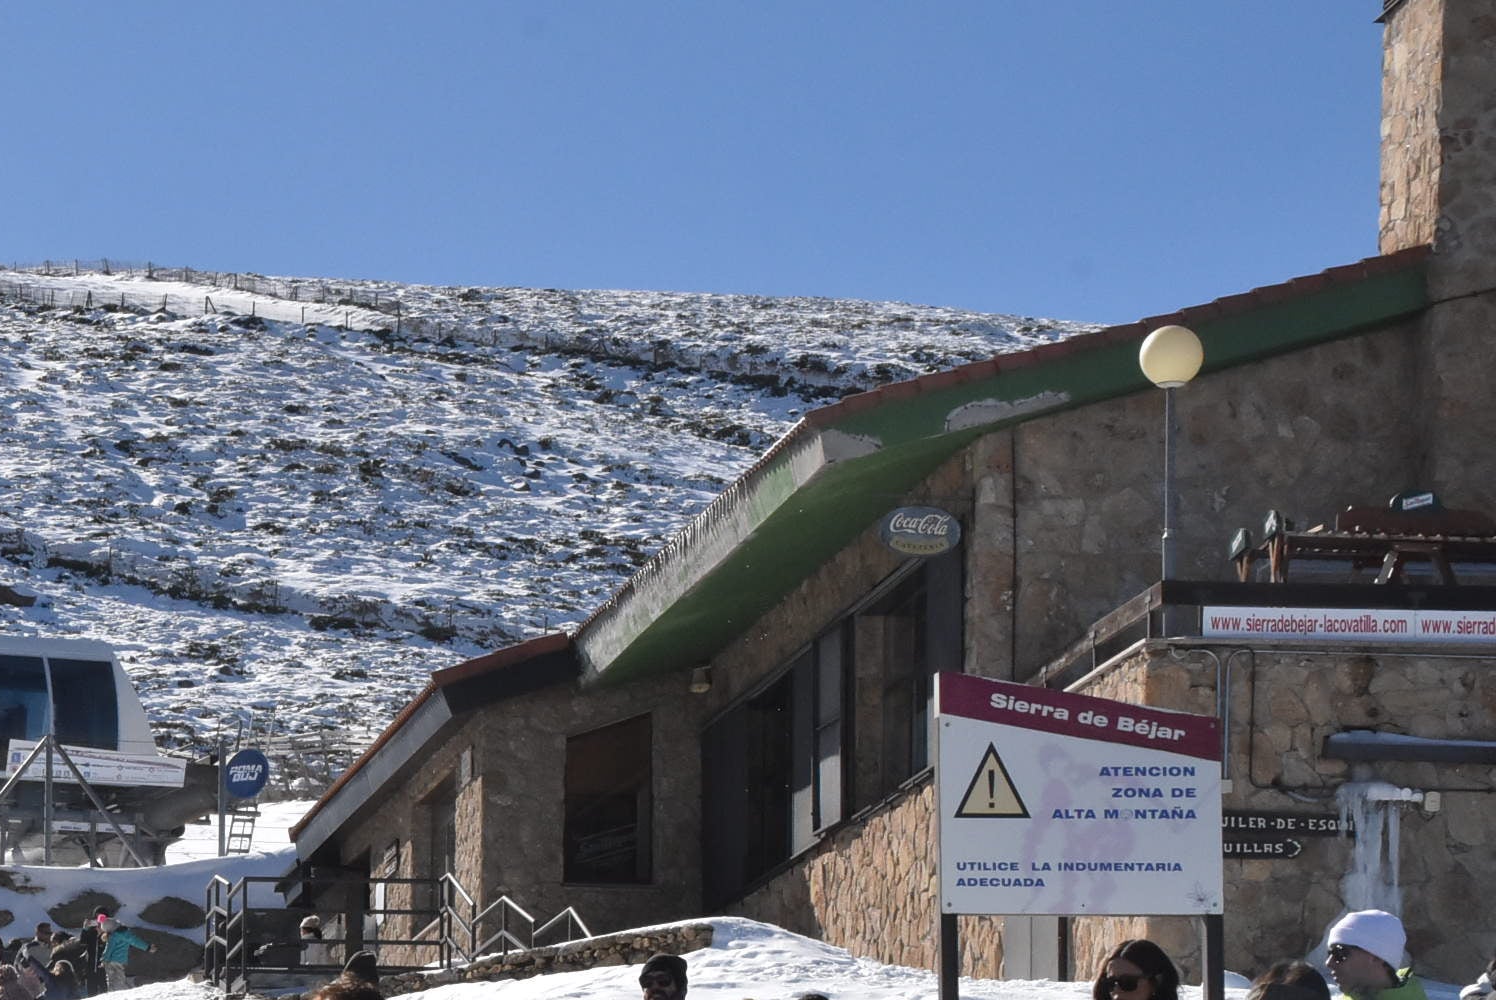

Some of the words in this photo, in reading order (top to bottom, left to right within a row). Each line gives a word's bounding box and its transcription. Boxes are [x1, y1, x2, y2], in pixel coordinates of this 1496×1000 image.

[890, 512, 951, 535] Coca-Cola
[1211, 613, 1408, 636] www.sierradebejar-lacovatilla.com
[990, 692, 1069, 721] Sierra
[1077, 710, 1109, 728] de
[1116, 716, 1186, 742] Béjar
[229, 765, 262, 775] POMA
[1098, 767, 1196, 777] ATENCION
[1112, 788, 1164, 798] ZONA
[1171, 788, 1197, 798] DE
[1052, 809, 1096, 819] ALTA
[956, 862, 1020, 871] UTILICE
[1031, 862, 1052, 871] LA
[1057, 862, 1183, 872] INDUMENTARIA
[956, 878, 1045, 887] ADECUADA
